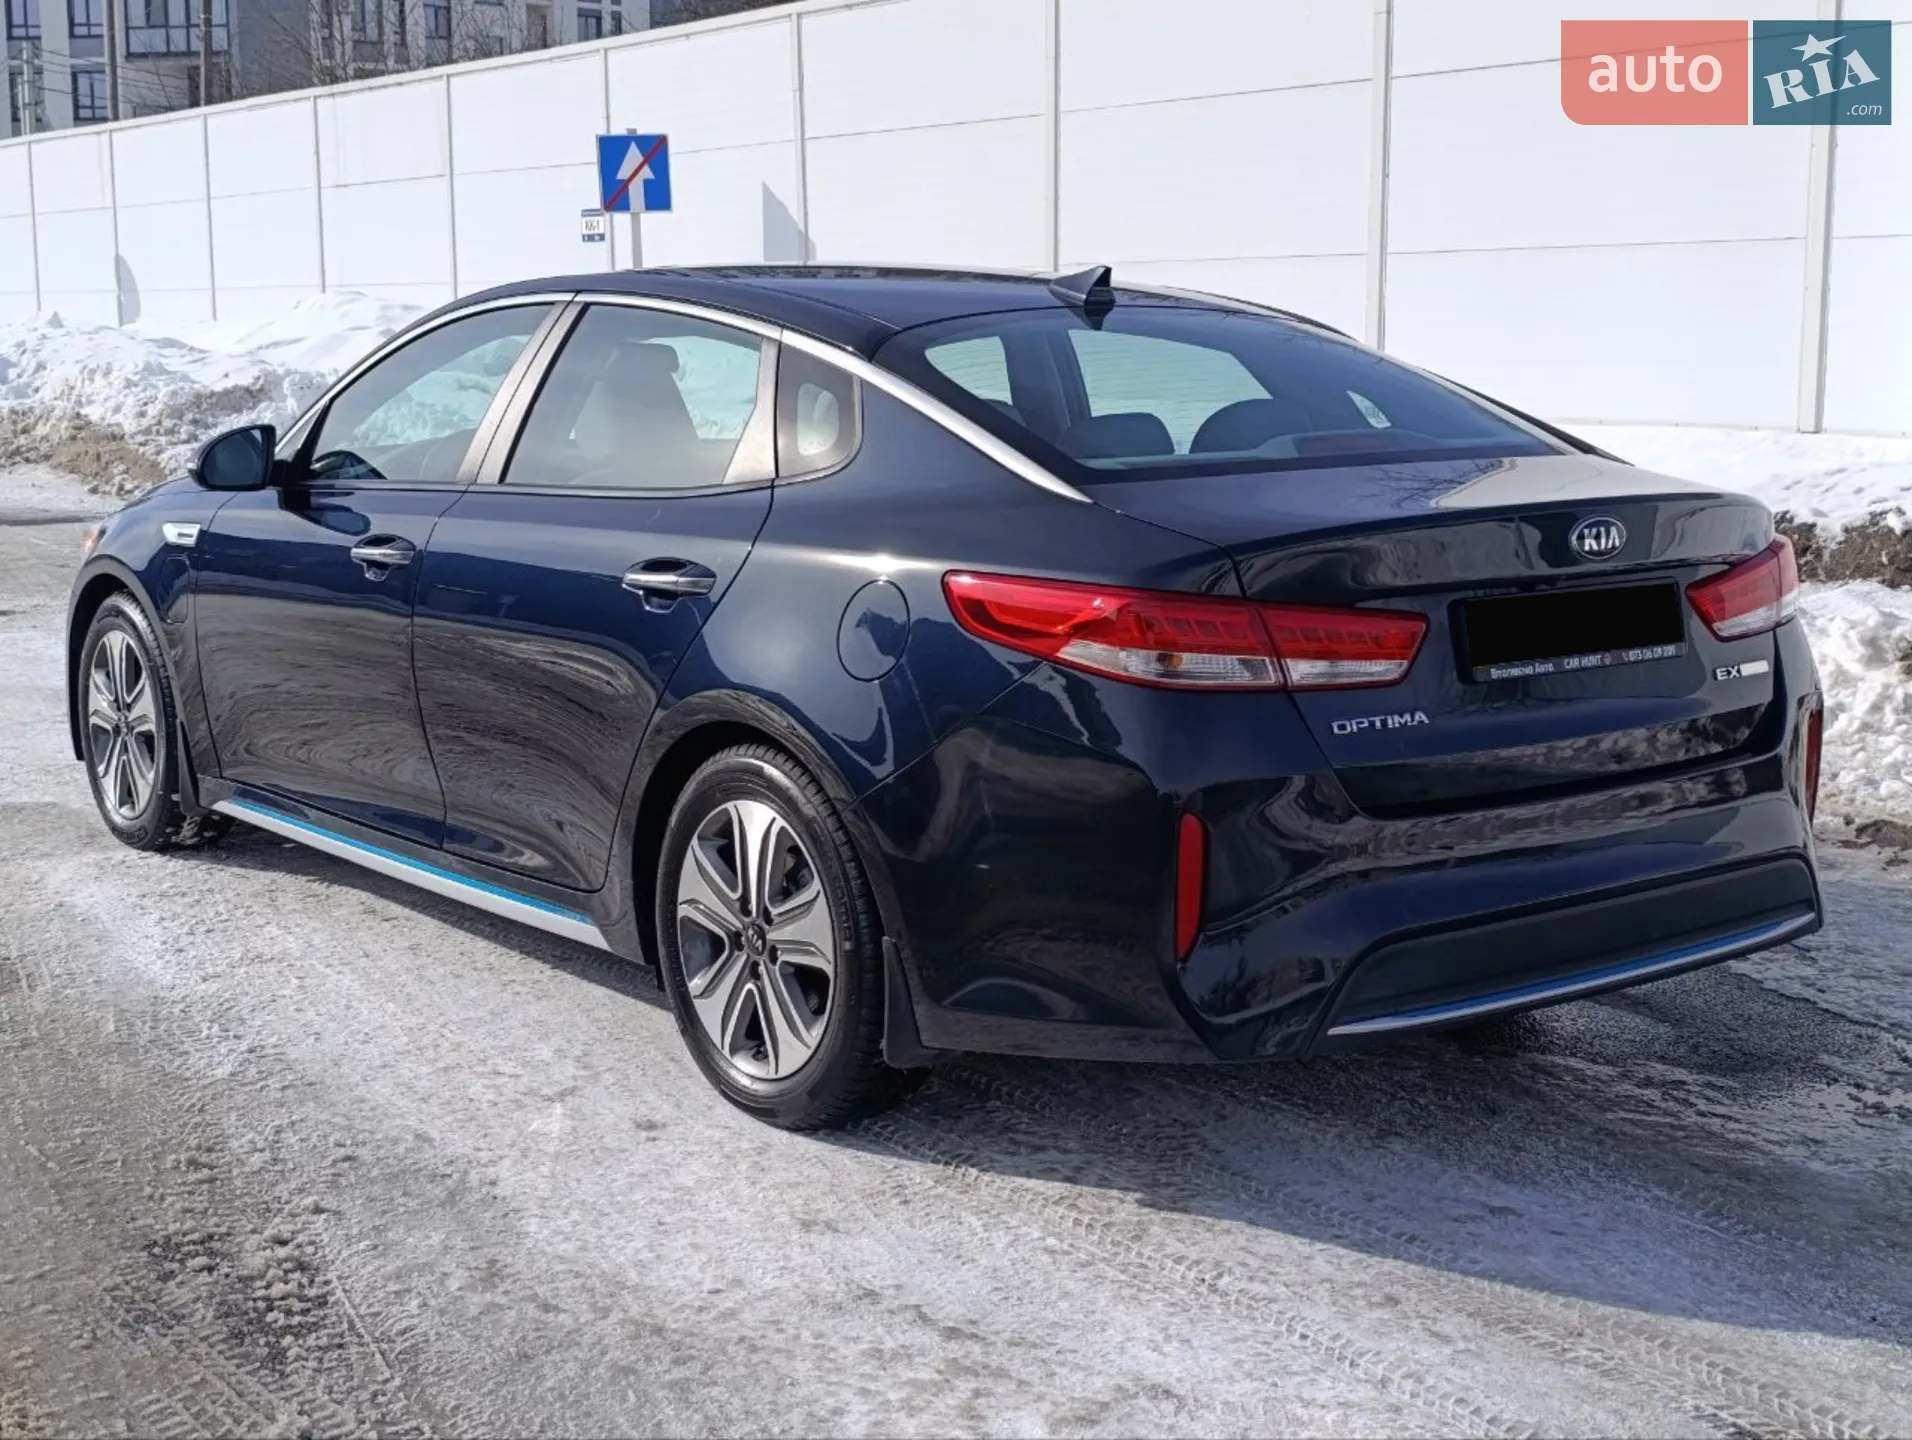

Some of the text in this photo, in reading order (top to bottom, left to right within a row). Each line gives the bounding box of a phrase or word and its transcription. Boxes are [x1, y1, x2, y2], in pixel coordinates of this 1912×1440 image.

[1583, 526, 1620, 550] KIA
[1563, 657, 1580, 669] CAR
[1715, 665, 1740, 681] EX
[1331, 710, 1430, 735] OPTIMA
